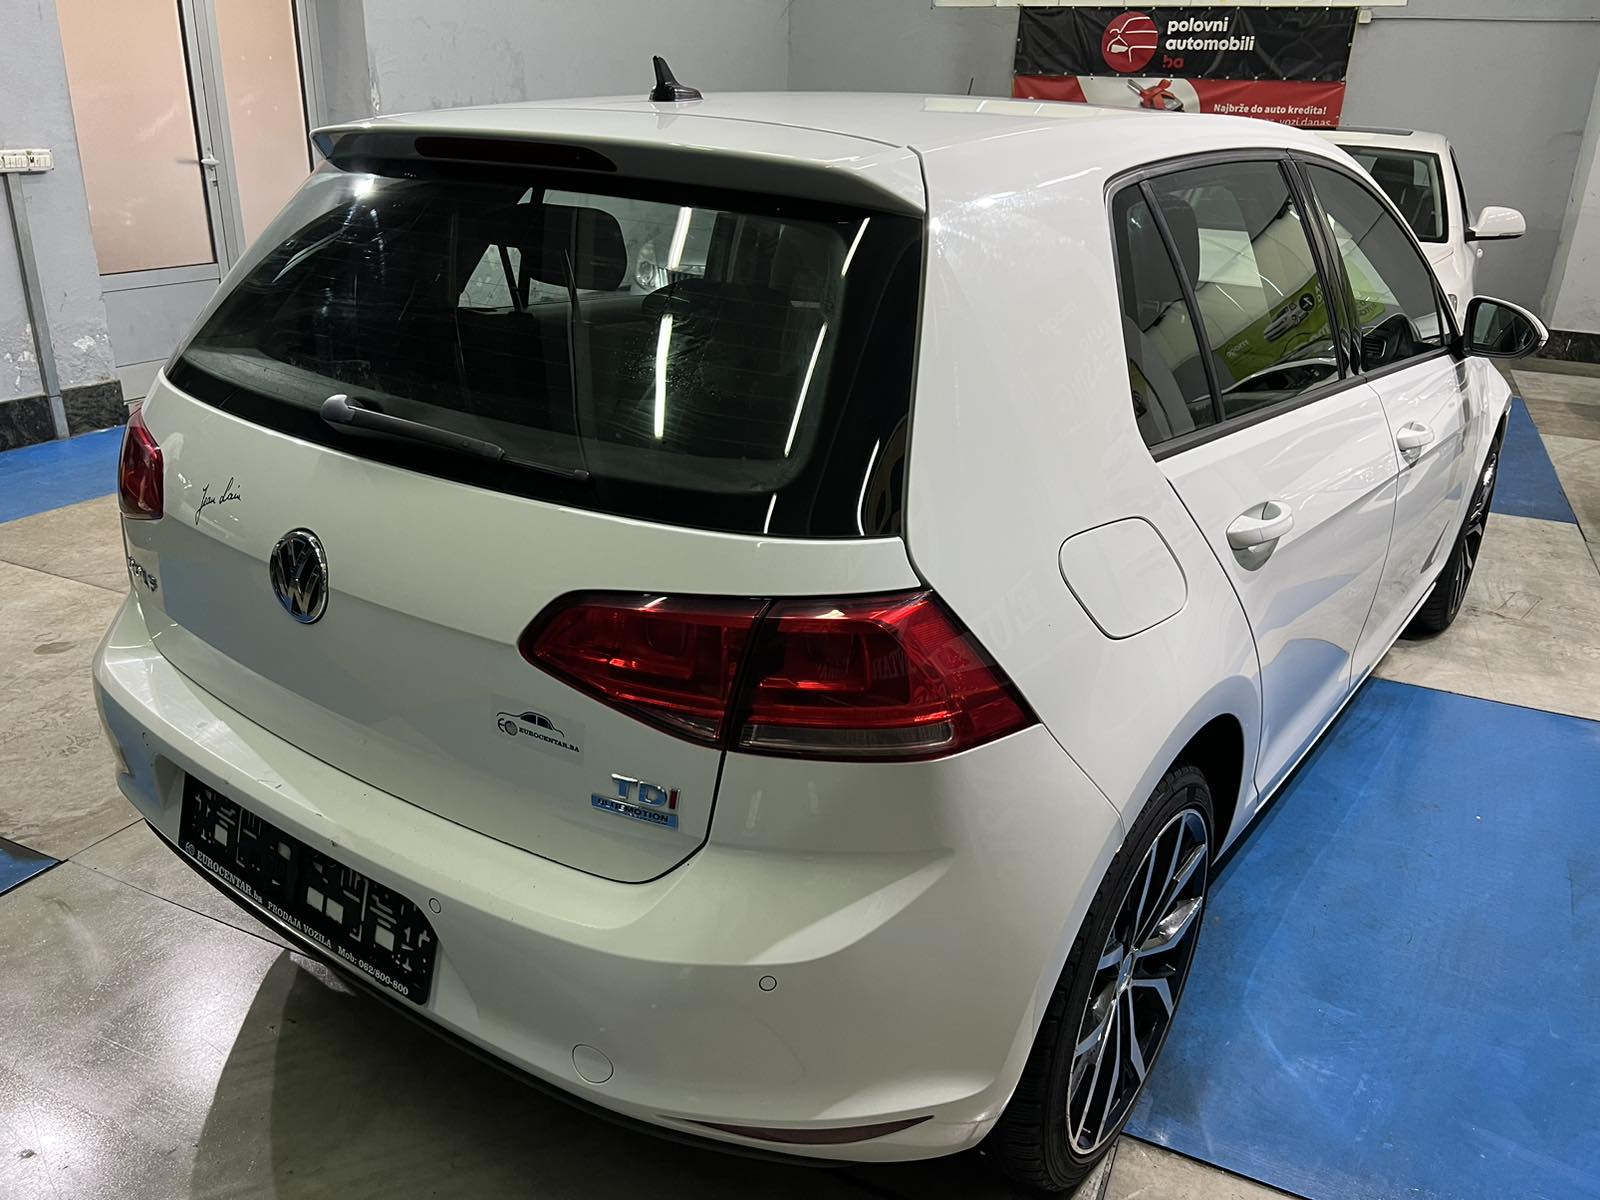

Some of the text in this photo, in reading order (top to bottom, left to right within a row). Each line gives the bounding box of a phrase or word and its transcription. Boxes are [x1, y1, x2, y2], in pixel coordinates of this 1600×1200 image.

[1167, 17, 1229, 35] polovni
[1165, 35, 1255, 51] automobili
[1213, 104, 1328, 116] Najbrže do auto kredita!
[611, 773, 681, 810] TDI
[196, 849, 409, 996] EUROCENTAR.ba PRODAJA VOZILA Mob: 062/800-800
